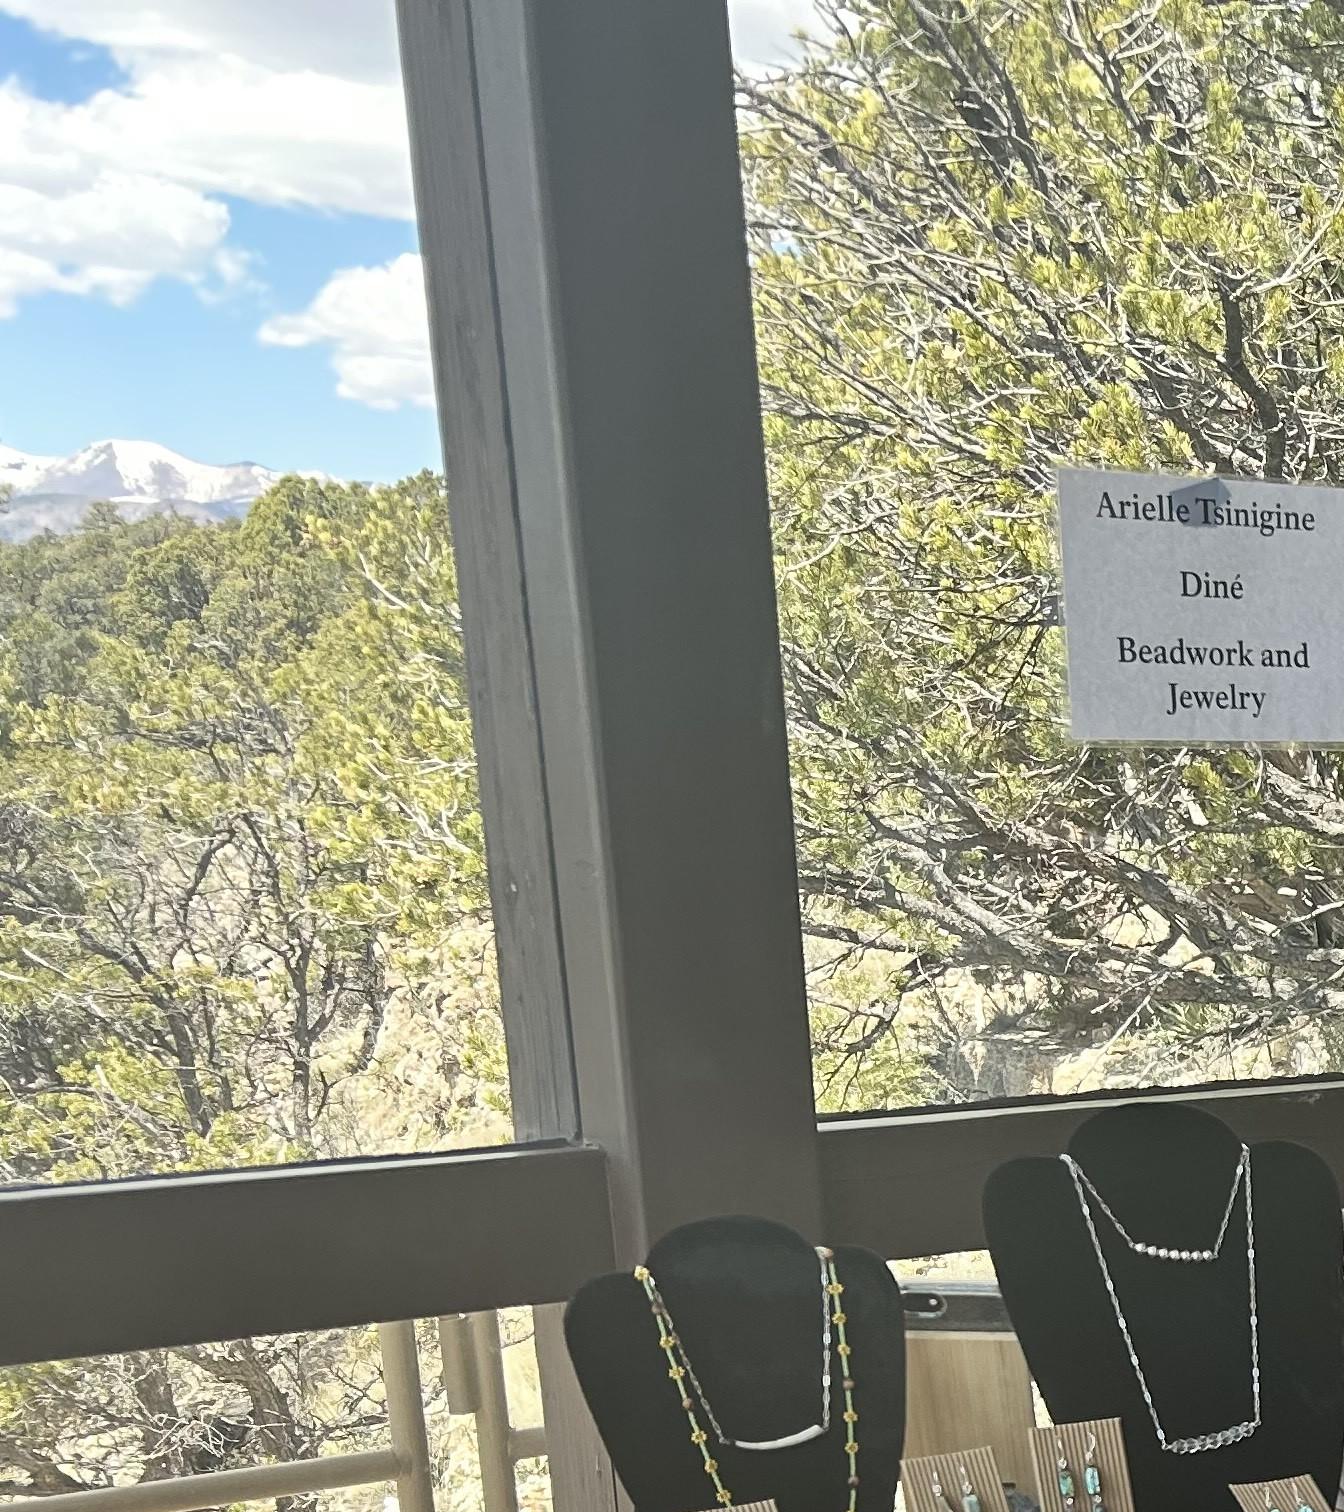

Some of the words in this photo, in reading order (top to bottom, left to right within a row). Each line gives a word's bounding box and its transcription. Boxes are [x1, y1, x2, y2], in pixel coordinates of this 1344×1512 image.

[1096, 491, 1190, 523] Arielle
[1195, 498, 1316, 537] Tsinigine
[1180, 571, 1244, 600] Diné
[1116, 636, 1255, 667] Beadwork
[1261, 643, 1311, 669] and
[1166, 682, 1267, 718] Jewelry
